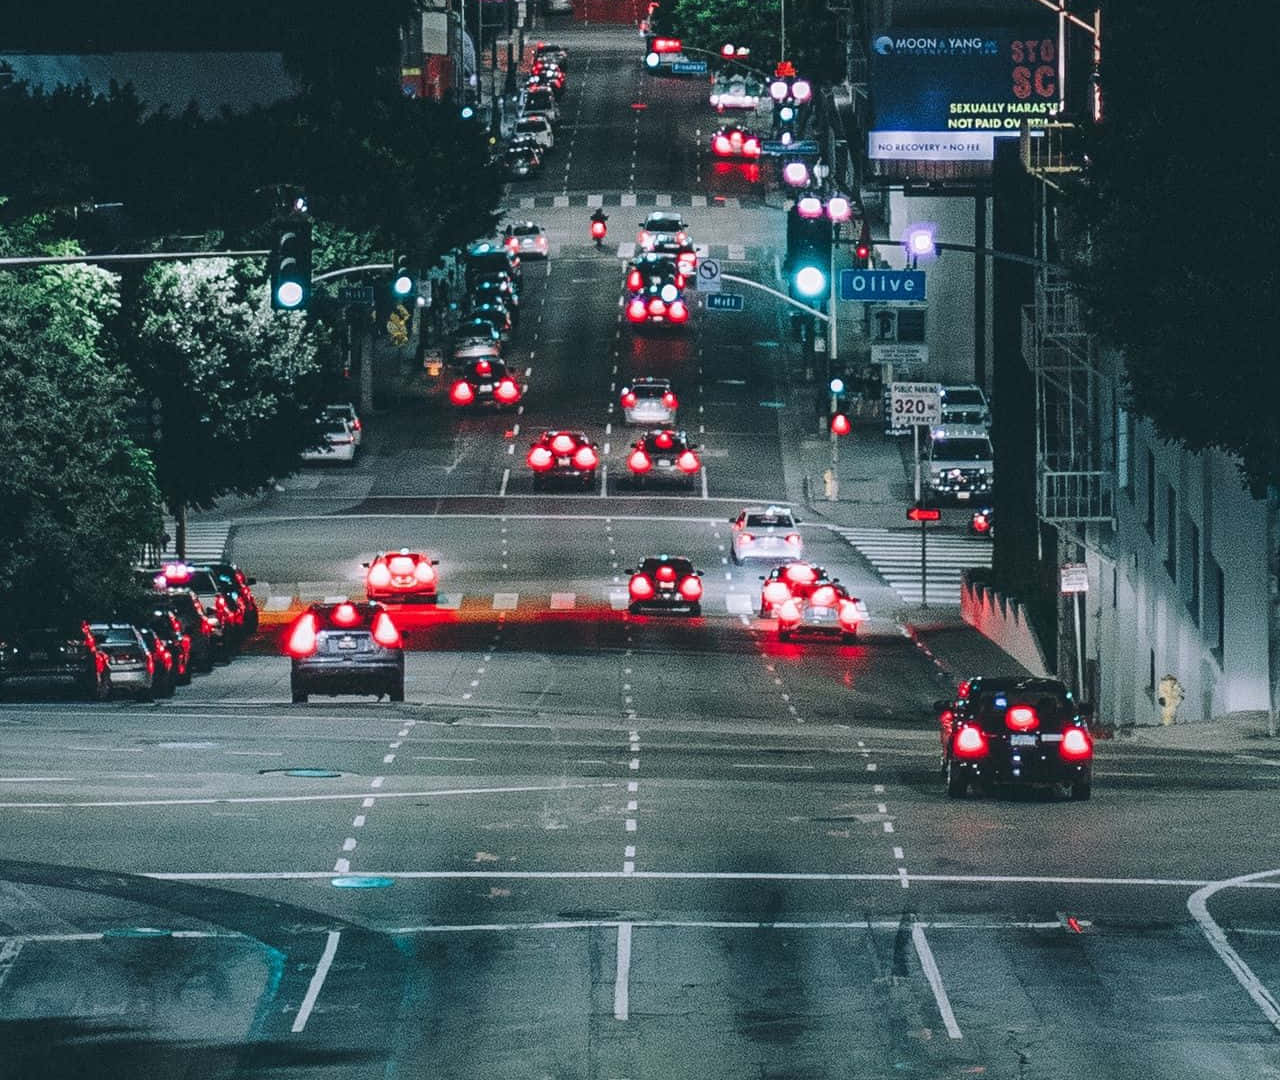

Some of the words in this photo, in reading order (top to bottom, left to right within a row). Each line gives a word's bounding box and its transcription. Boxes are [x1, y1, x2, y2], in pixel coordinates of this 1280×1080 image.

[895, 38, 937, 49] MOON
[948, 37, 983, 49] YANG
[1011, 65, 1055, 99] SC
[950, 103, 1005, 113] SEXUALLY
[948, 119, 973, 129] NOT
[975, 119, 1001, 129] PAID
[878, 143, 893, 151] NO
[895, 143, 940, 151] RECOVERY
[949, 143, 964, 151] NO
[852, 275, 915, 292] Olive
[714, 297, 736, 308] Hill
[895, 399, 925, 414] 320
